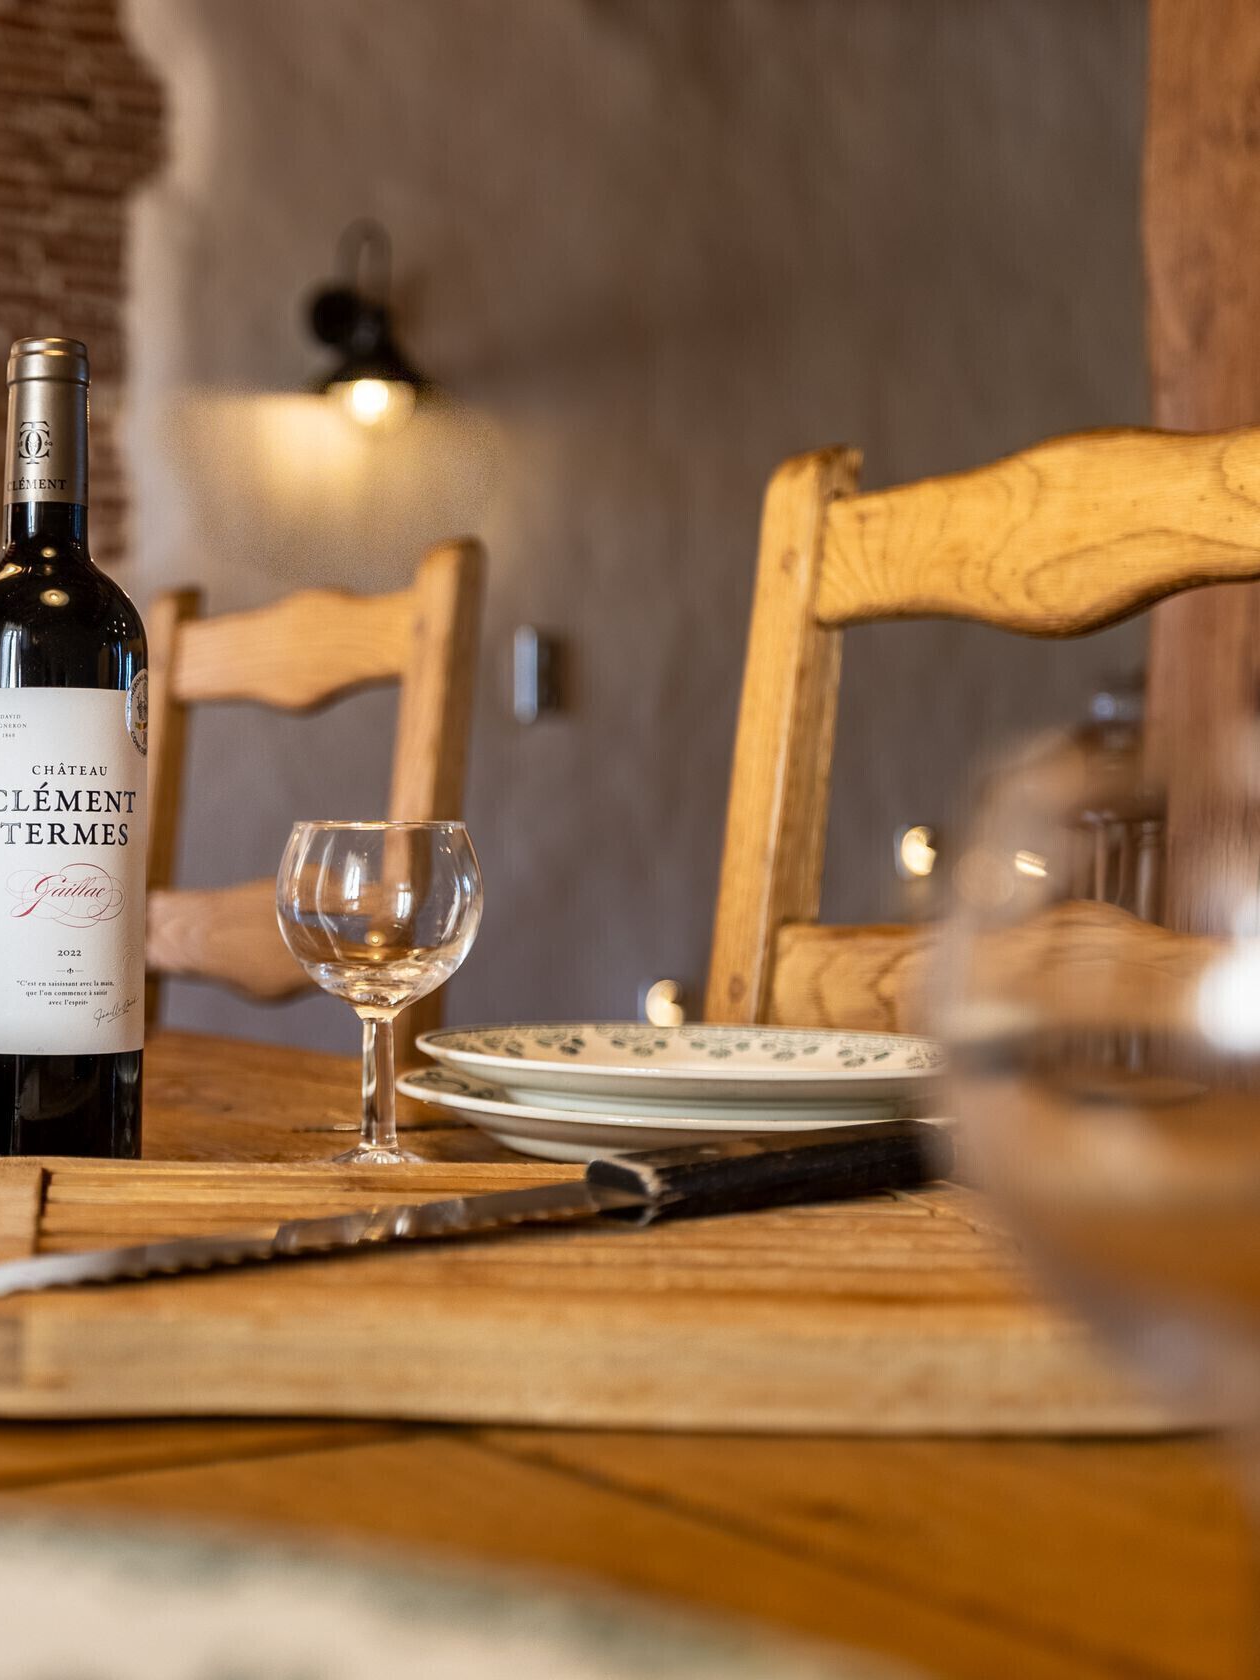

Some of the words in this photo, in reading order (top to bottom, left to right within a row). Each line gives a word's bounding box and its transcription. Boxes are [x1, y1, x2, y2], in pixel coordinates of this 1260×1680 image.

[6, 477, 67, 491] CLÉMENT
[31, 762, 108, 776] CHÂTEAU
[0, 821, 129, 846] TERMES
[8, 864, 118, 923] Gaillac
